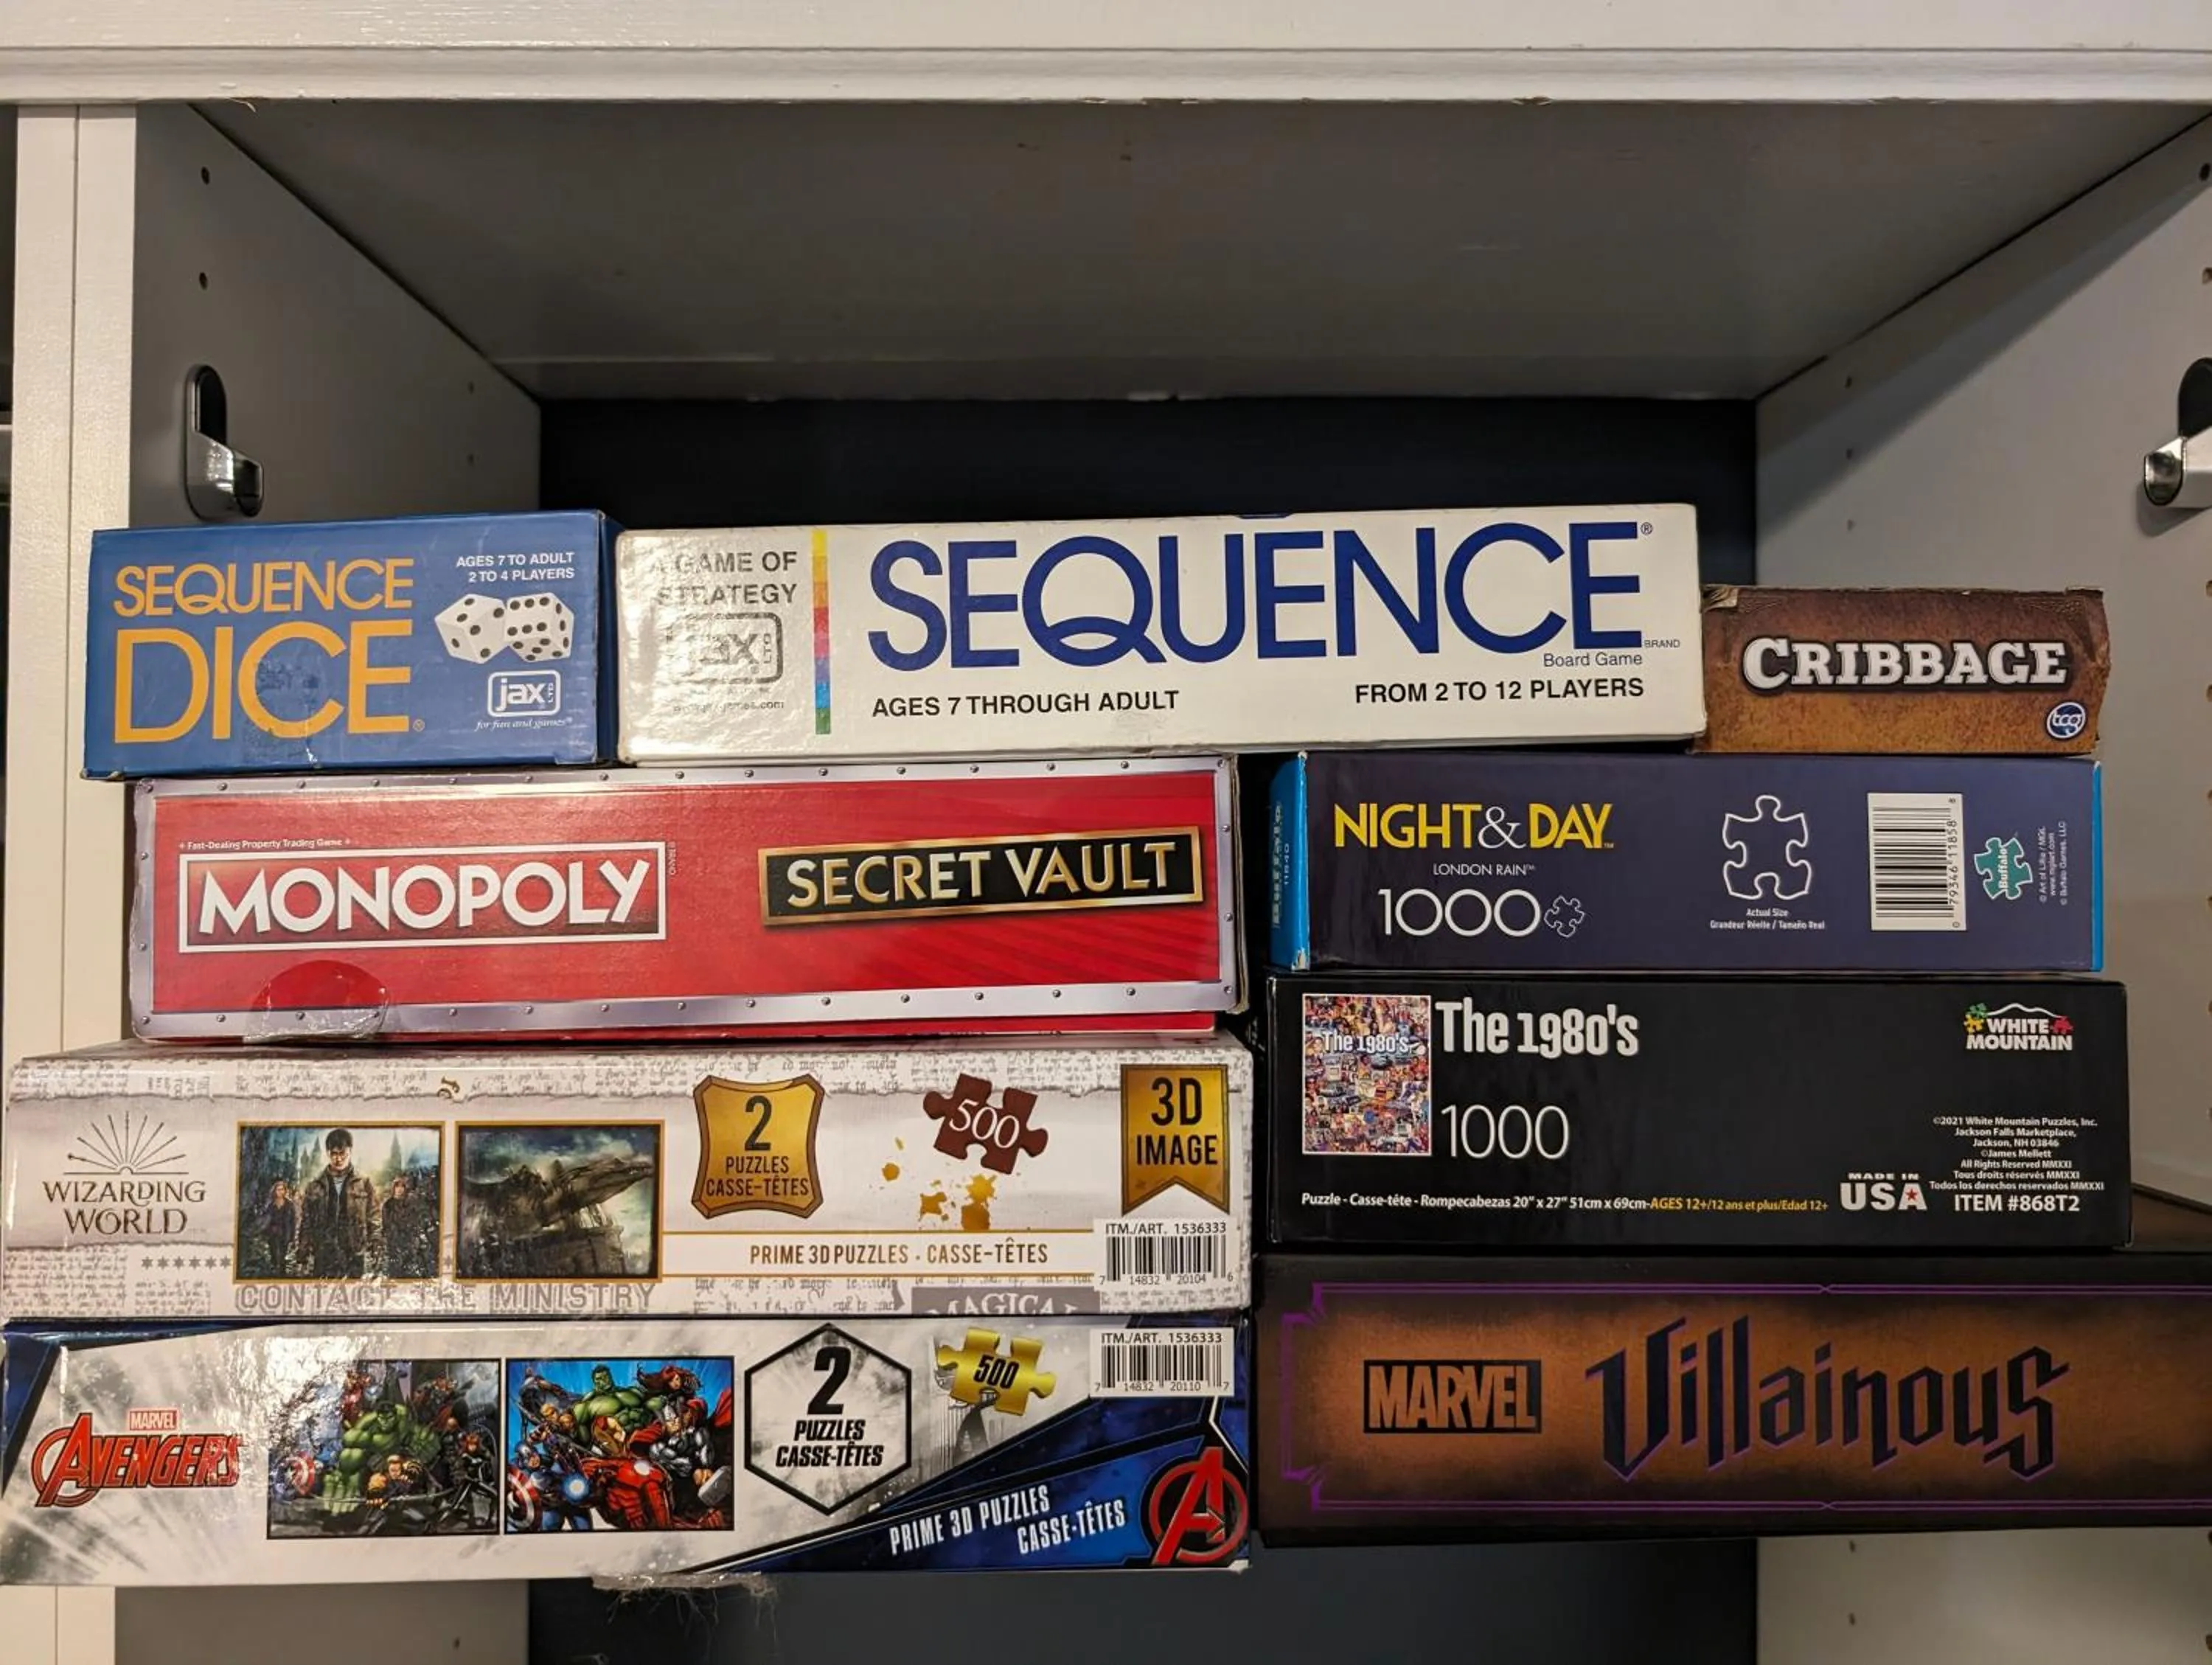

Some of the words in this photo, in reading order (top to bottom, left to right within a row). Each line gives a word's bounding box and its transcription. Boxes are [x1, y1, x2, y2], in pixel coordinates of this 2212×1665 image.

[456, 555, 494, 567] AGES
[498, 555, 504, 566] 7
[507, 554, 526, 566] TO
[530, 552, 575, 566] ADULT
[675, 552, 754, 573] GAME
[762, 551, 798, 571] OF
[468, 571, 476, 583] 2
[479, 570, 497, 582] TO
[501, 569, 509, 581] 4
[512, 567, 575, 580] PLAYERS
[113, 558, 414, 618] SEQUENCE
[652, 583, 798, 605] STRATEGY
[762, 633, 772, 664] LTD
[1644, 639, 1681, 649] BRAND
[1543, 653, 1590, 668] Board
[1594, 652, 1643, 667] Game
[1742, 637, 2069, 690] CRIBBAGE
[114, 619, 413, 743] DICE
[1355, 682, 1428, 704] FROM
[1435, 681, 1450, 703] 2
[1453, 681, 1486, 702] TO
[1495, 680, 1523, 701] 12
[1530, 678, 1644, 700] PLAYERS
[495, 678, 546, 712] jax
[872, 696, 939, 717] AGES
[947, 695, 961, 715] 7
[965, 693, 1091, 716] THROUGH
[1098, 690, 1180, 712] ADULT
[243, 840, 281, 850] Property
[282, 839, 315, 849] Trading
[317, 838, 343, 847] Game
[1947, 820, 1958, 857] 11858
[787, 849, 991, 908] SECRET
[1004, 841, 1178, 898] VAULT
[1433, 863, 1492, 876] LONDON
[1997, 847, 2008, 889] Buffalo
[198, 859, 651, 935] MONOPOLY
[1378, 889, 1541, 936] 1000
[1746, 908, 1770, 917] Actual
[1772, 908, 1790, 917] Size
[1710, 920, 1745, 930] Grandeur
[1435, 997, 1509, 1053] The
[1517, 1004, 1639, 1060] 1980's
[1986, 1018, 2050, 1034] WHITE
[1323, 1029, 1354, 1052] The
[1356, 1034, 1410, 1054] 1980's
[1966, 1035, 2073, 1051] MOUNTAIN
[1151, 1077, 1203, 1126] 3D
[744, 1096, 773, 1151] 2
[949, 1099, 1020, 1150] 500
[1441, 1104, 1570, 1159] 1000
[1955, 1127, 1992, 1137] Jackson
[1993, 1127, 2014, 1136] Falls
[1965, 1116, 1993, 1125] White
[1994, 1117, 2040, 1126] Mountain
[2042, 1117, 2079, 1127] Puzzles,
[2081, 1118, 2098, 1126] Inc.
[1136, 1134, 1218, 1166] IMAGE
[2018, 1150, 2051, 1158] Mellett
[725, 1156, 789, 1175] PUZZLES
[1953, 1170, 1975, 1179] Tous
[1978, 1170, 2003, 1179] droits
[2046, 1171, 2080, 1179] MMXXI
[1961, 1160, 1972, 1168] All
[1974, 1160, 2000, 1169] Rights
[2003, 1160, 2040, 1168] Reserved
[2042, 1160, 2073, 1168] MMXXI
[42, 1180, 207, 1207] WIZARDING
[1840, 1182, 1927, 1211] USA
[1929, 1181, 1957, 1189] Todos
[1959, 1181, 1972, 1189] los
[1975, 1181, 2017, 1190] derechos
[2018, 1181, 2068, 1190] reservados
[2070, 1182, 2104, 1190] MMXXI
[1301, 1192, 1341, 1206] Puzzle
[1421, 1195, 1511, 1210] Rompecabezas
[1536, 1199, 1544, 1209] x
[1569, 1197, 1601, 1209] 51cm
[1604, 1200, 1612, 1209] x
[1725, 1201, 1744, 1210] ans
[1745, 1200, 1756, 1210] et
[1809, 1200, 1829, 1210] 12+
[1955, 1194, 2003, 1212] ITEM
[2007, 1194, 2080, 1212] #868T2
[64, 1208, 188, 1235] WORLD
[1174, 1222, 1226, 1234] 1536333
[750, 1245, 804, 1264] PRIME
[809, 1245, 830, 1264] 3D
[834, 1244, 908, 1264] PUZZLES
[1130, 1275, 1160, 1285] 14832
[1177, 1274, 1207, 1285] 20104
[236, 1284, 394, 1314] CONTACT
[490, 1284, 655, 1314] MINISTRY
[1169, 1332, 1222, 1343] 1536333
[807, 1346, 852, 1414] 2
[973, 1355, 1020, 1390] 500
[1124, 1382, 1154, 1391] 14832
[1170, 1382, 1201, 1391] 20110
[1367, 1363, 1538, 1429] MARVEL
[1585, 1315, 2070, 1483] Villainous
[130, 1411, 178, 1430] MARVEL
[794, 1419, 866, 1441] PUZZLES
[34, 1412, 243, 1507] AVENGERS
[888, 1518, 946, 1555] PRIME
[951, 1509, 974, 1537] 3D
[979, 1484, 1050, 1530] PUZZLES
